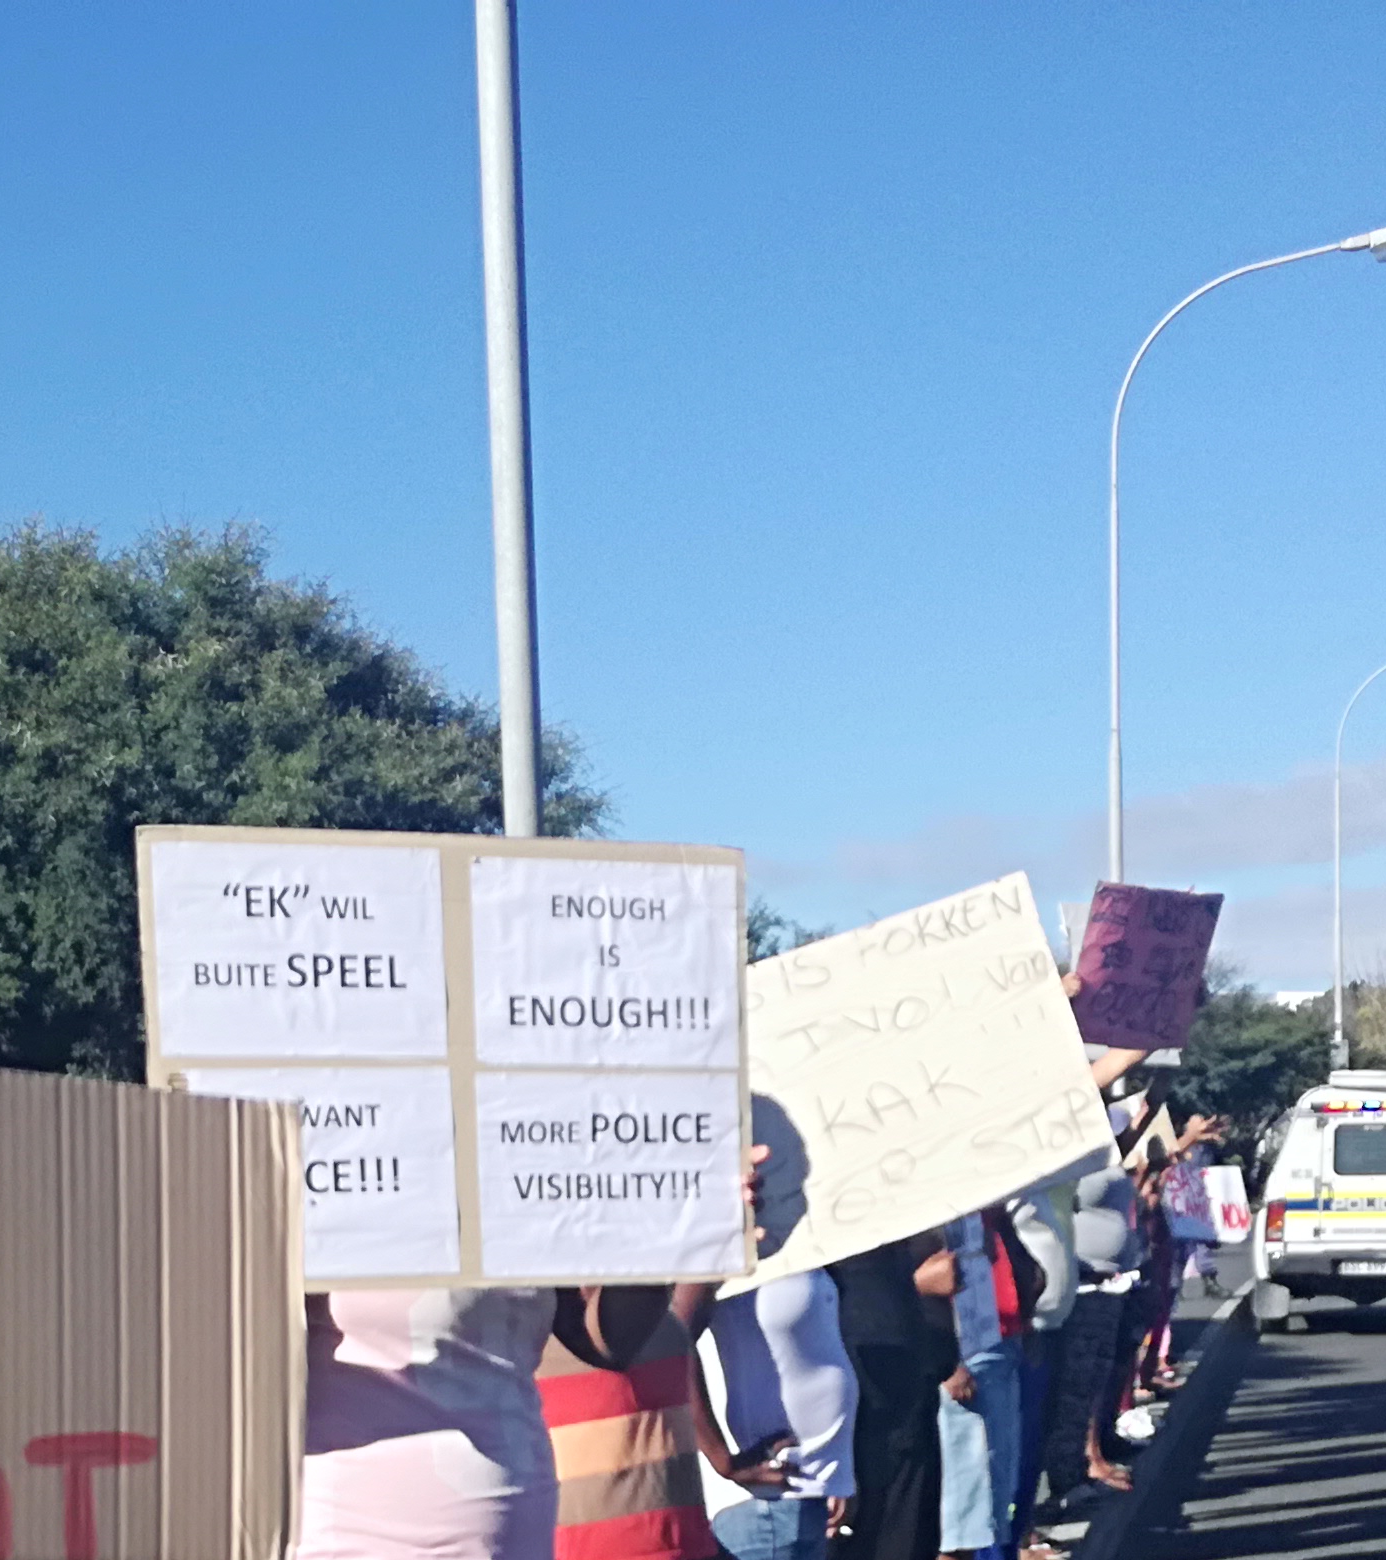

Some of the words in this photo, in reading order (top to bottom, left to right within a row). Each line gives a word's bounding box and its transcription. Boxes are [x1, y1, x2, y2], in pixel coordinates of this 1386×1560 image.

[222, 882, 311, 920] “EK”
[321, 895, 375, 921] WIL
[550, 894, 666, 922] ENOUGH
[194, 962, 278, 987] BUITE
[286, 953, 408, 989] SPEEL
[600, 945, 621, 968] IS
[508, 995, 712, 1031] ENOUGH!!!
[500, 1120, 581, 1144] MORE
[590, 1112, 714, 1144] POLICE
[514, 1172, 703, 1201] VISIBILITY!!!
